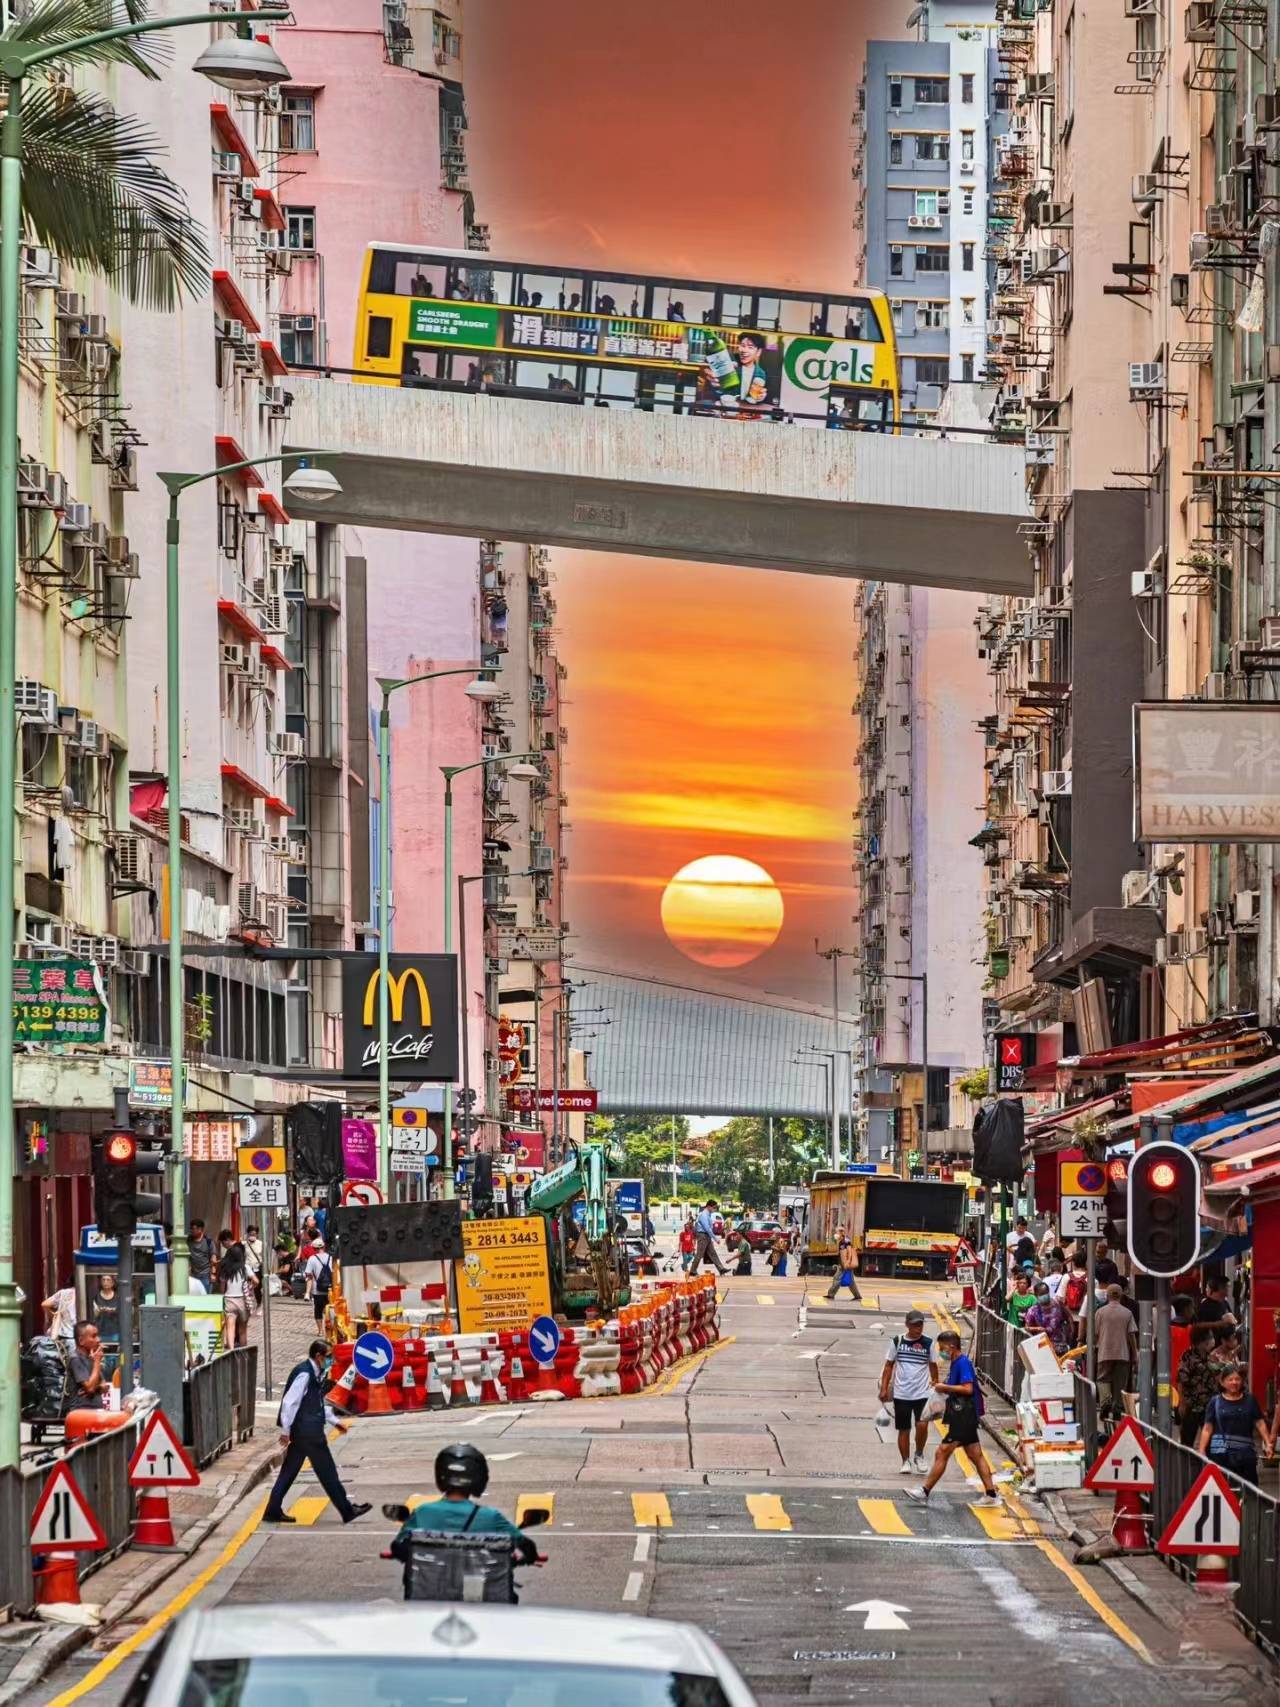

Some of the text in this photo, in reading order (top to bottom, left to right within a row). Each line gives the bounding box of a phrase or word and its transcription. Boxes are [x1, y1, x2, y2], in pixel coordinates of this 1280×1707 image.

[417, 309, 460, 319] CARLSBERG
[417, 317, 488, 329] SMOOTH DRAUGHT
[1152, 805, 1280, 826] HARVES
[56, 1007, 100, 1019] 4398
[17, 1021, 26, 1030] A
[1002, 1066, 1022, 1078] DBS
[414, 1141, 421, 1149] 7
[244, 1177, 281, 1187] 24 hrs
[249, 1189, 277, 1202] 全日
[1070, 1200, 1104, 1211] 24 hr
[1074, 1215, 1107, 1232] 全日
[478, 1232, 539, 1246] 2814 3443
